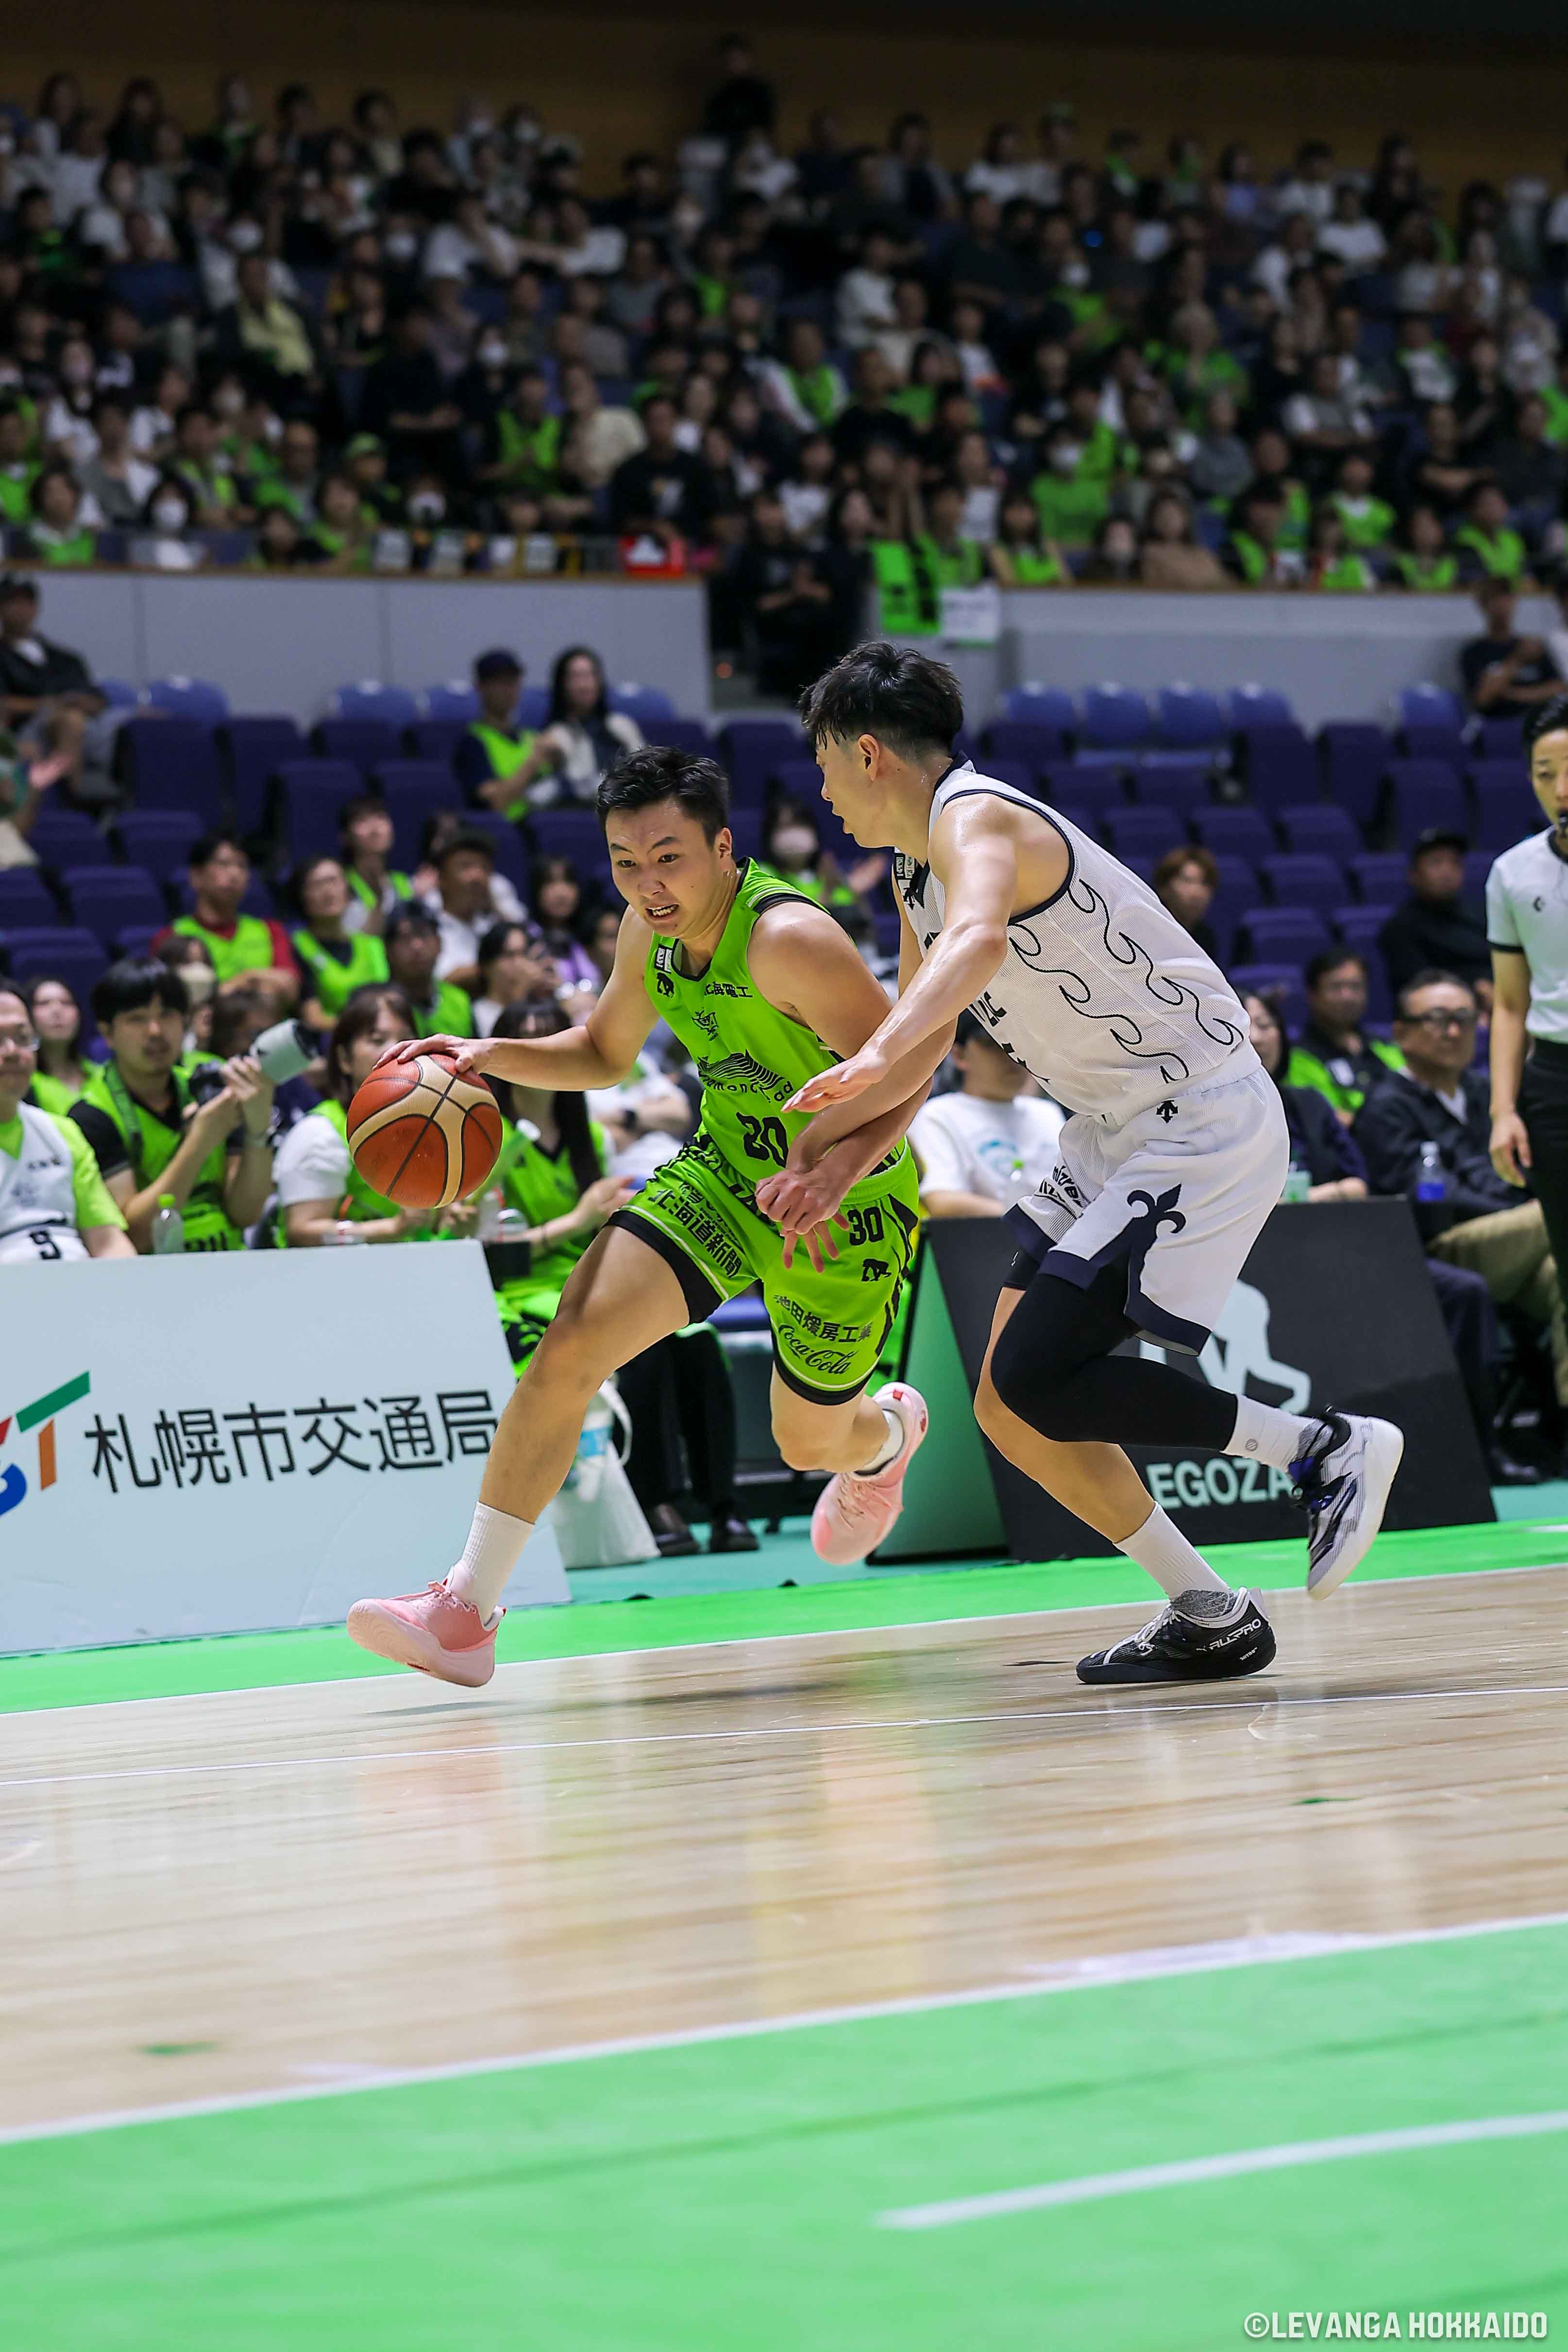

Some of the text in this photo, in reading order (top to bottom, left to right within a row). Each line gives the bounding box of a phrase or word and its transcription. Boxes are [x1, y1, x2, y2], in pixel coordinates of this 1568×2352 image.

[846, 1206, 884, 1246] 30
[84, 1389, 498, 1494] 札幌市交通局
